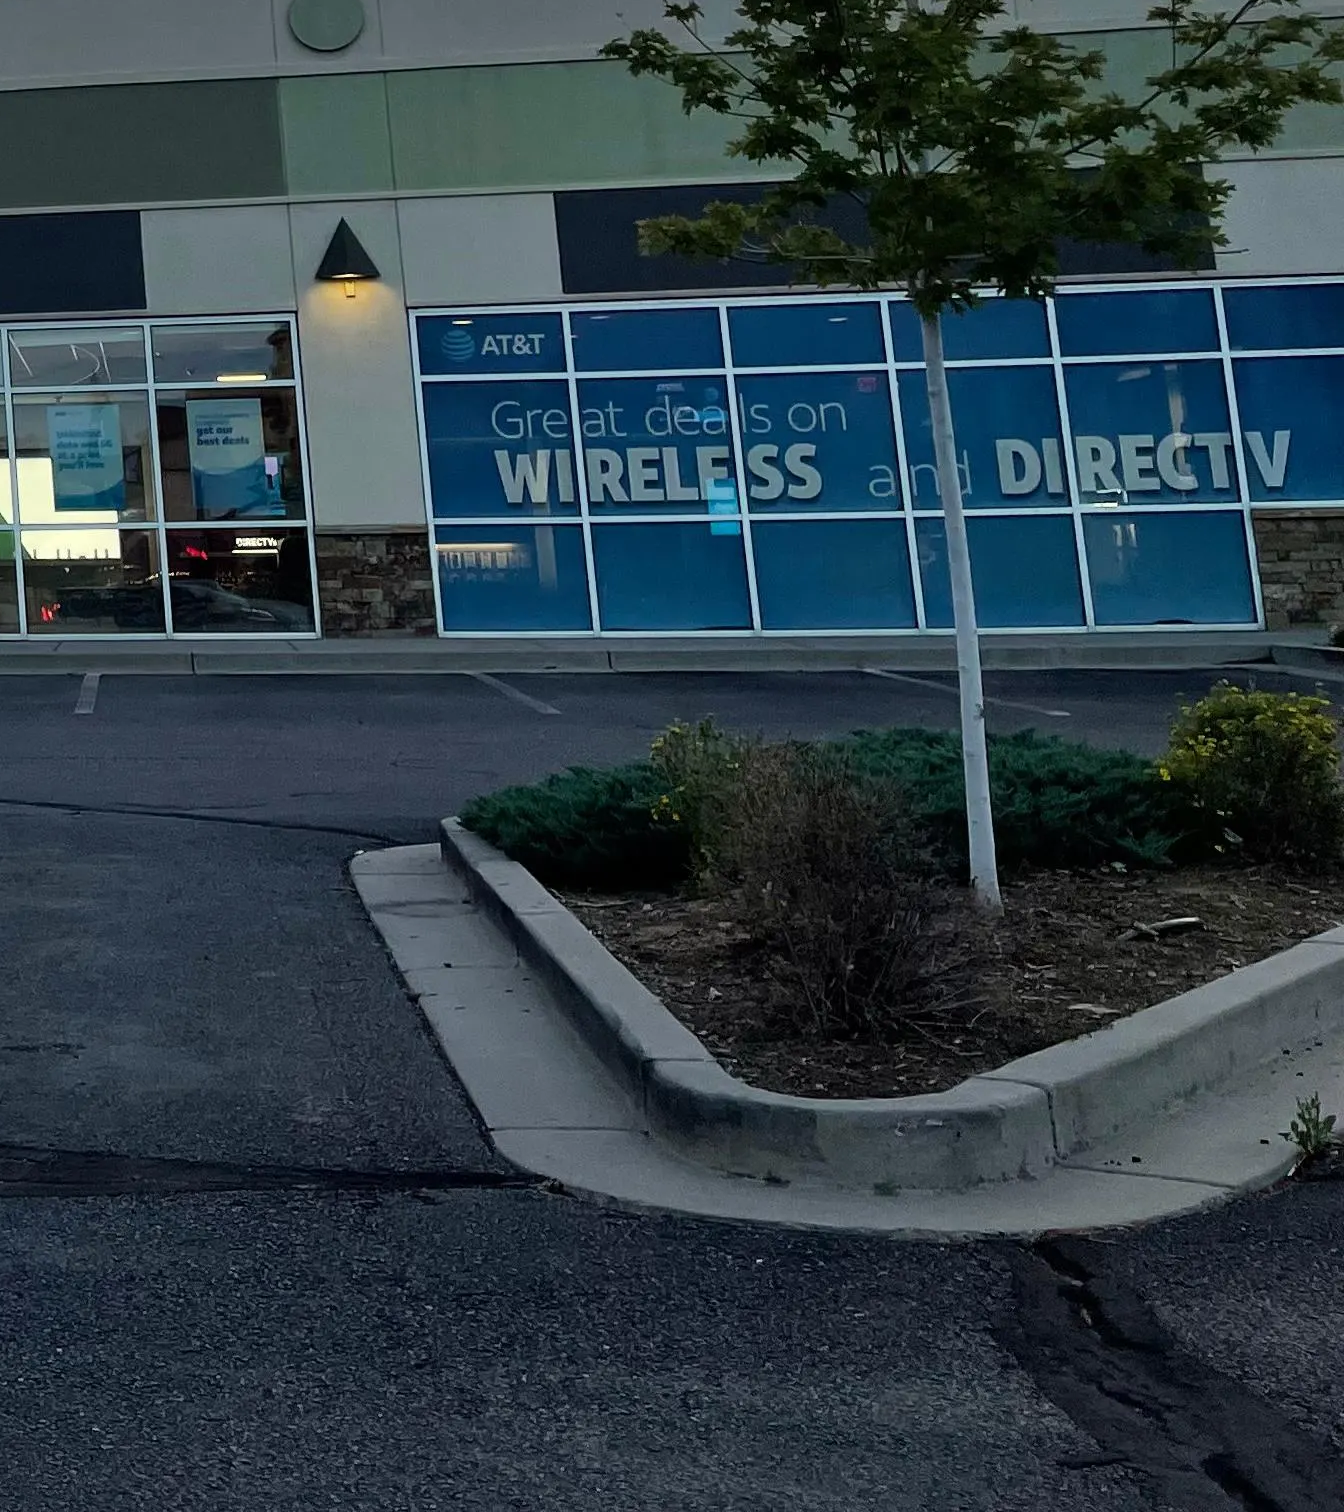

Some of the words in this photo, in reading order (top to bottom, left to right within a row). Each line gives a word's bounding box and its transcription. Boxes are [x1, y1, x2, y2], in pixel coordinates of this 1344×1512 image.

[480, 333, 545, 356] AT&T
[491, 400, 628, 439] Great
[645, 393, 772, 436] deals
[787, 401, 847, 433] on
[494, 443, 823, 504] WIRELESS
[995, 429, 1291, 495] DIRECTV
